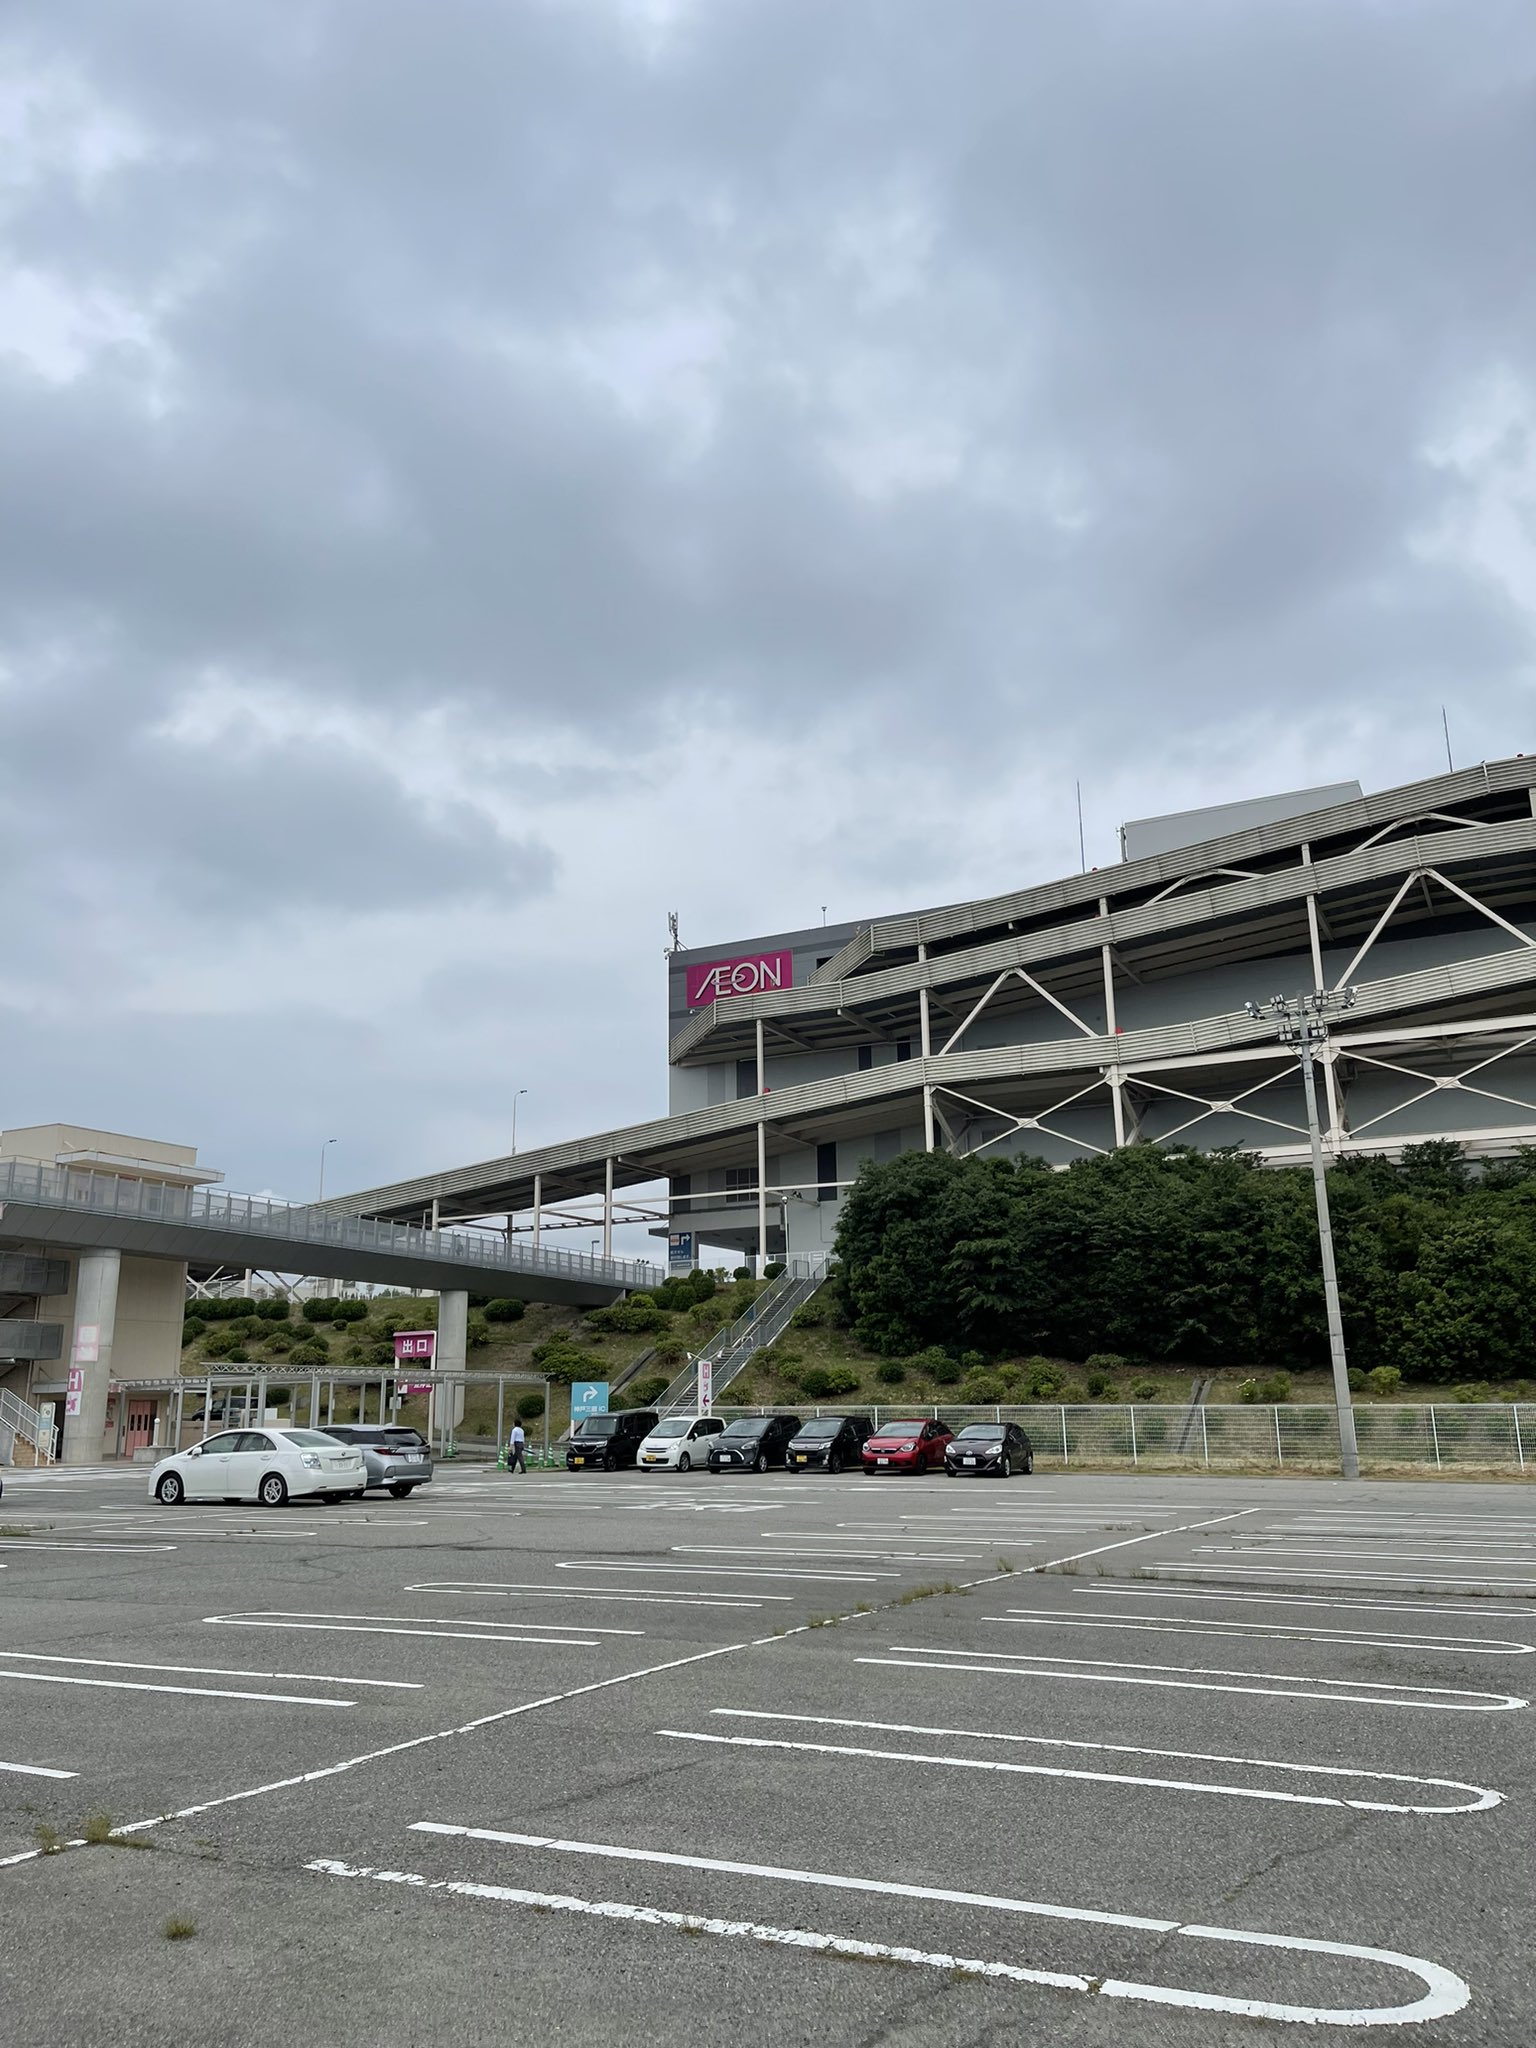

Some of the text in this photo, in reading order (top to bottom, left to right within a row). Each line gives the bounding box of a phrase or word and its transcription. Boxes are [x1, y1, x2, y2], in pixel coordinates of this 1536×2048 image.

[402, 1339, 427, 1354] 出口
[68, 1371, 79, 1390] H
[598, 1405, 606, 1413] IC
